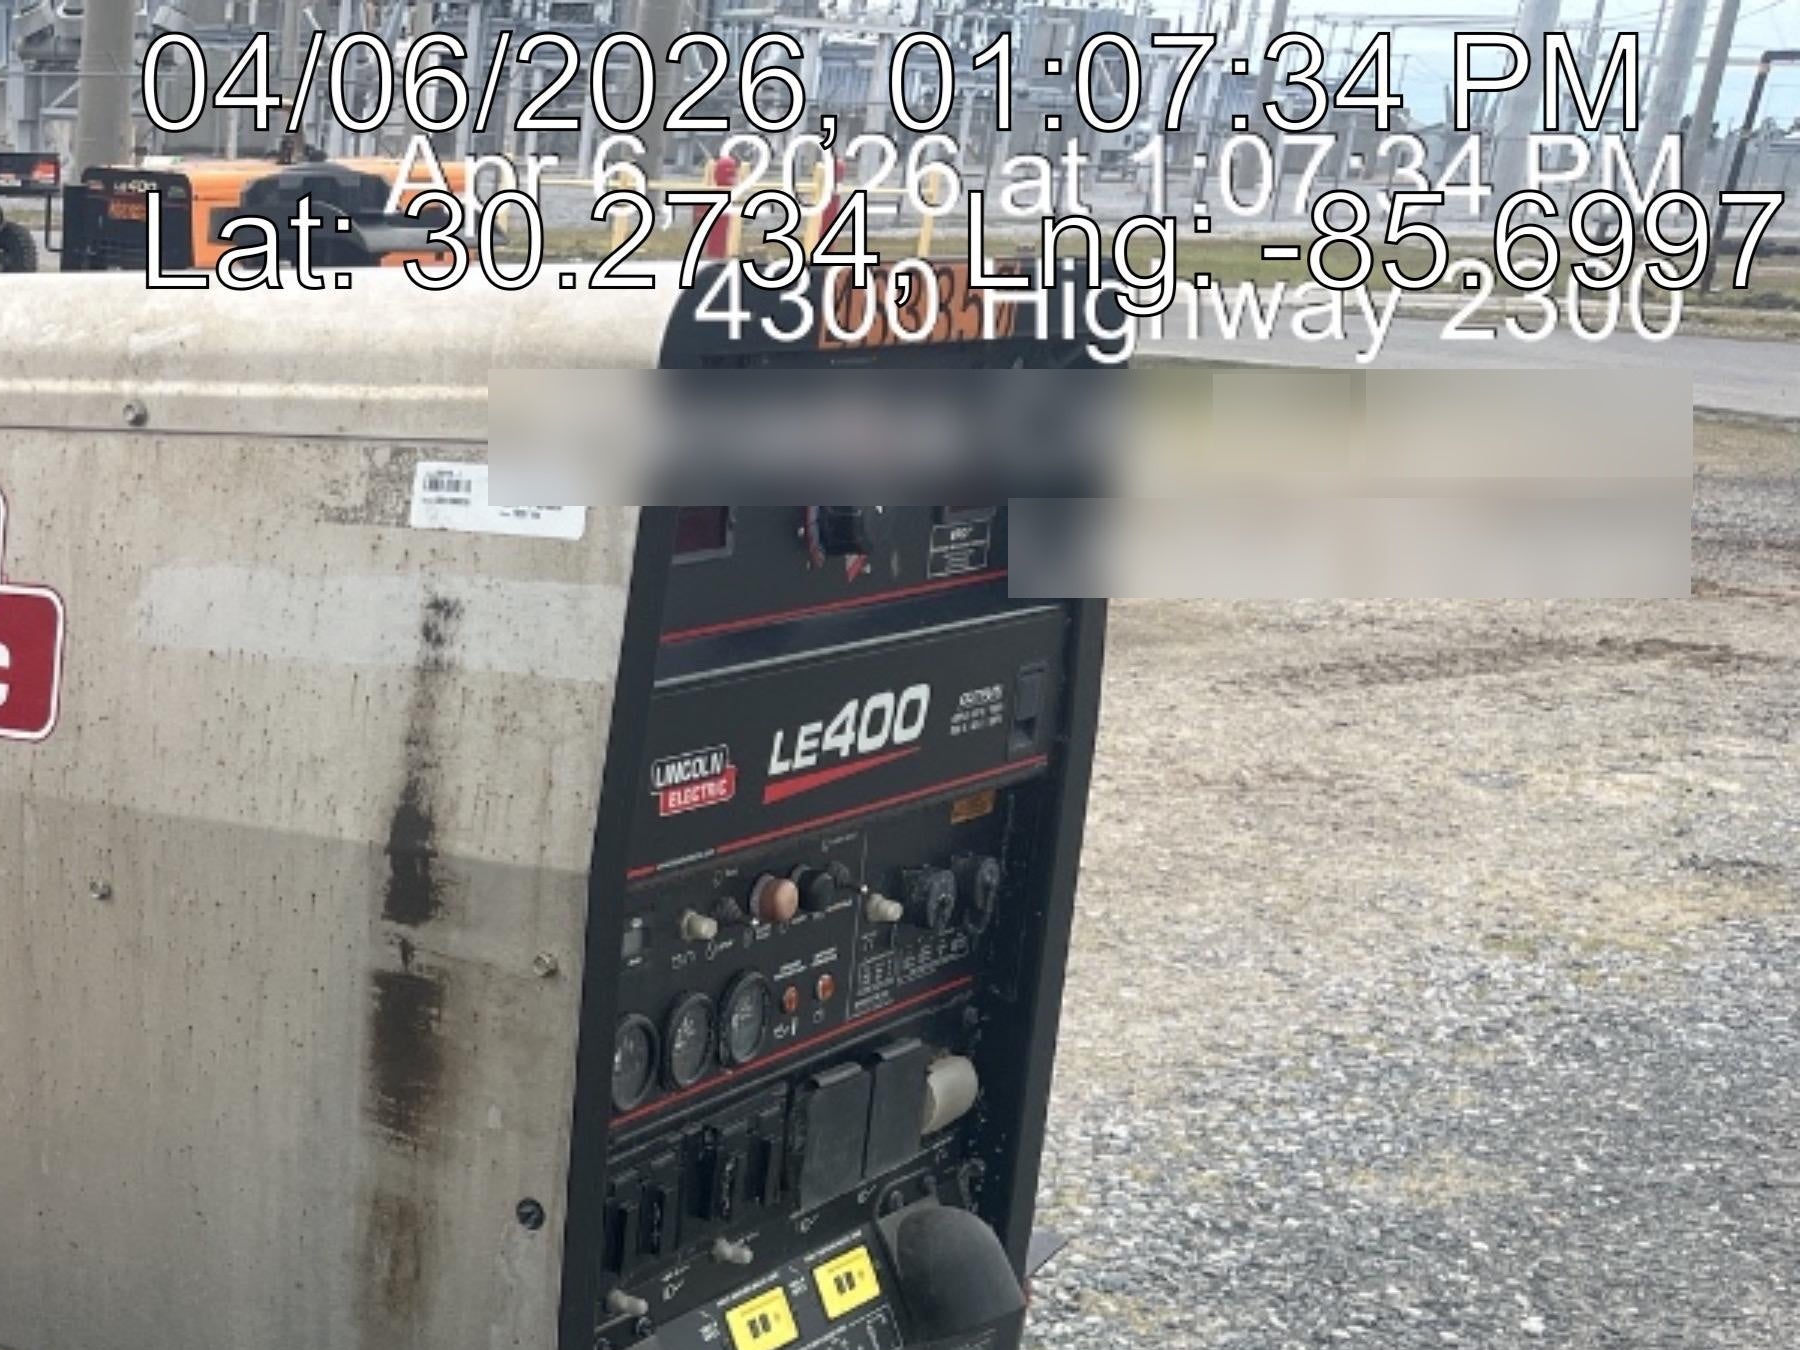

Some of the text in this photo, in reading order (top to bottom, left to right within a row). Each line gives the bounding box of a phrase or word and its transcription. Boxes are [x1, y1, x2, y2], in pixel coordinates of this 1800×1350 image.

[768, 683, 931, 776] LE400
[654, 752, 725, 788] LINCOLN
[668, 776, 729, 808] ELECTRIC
